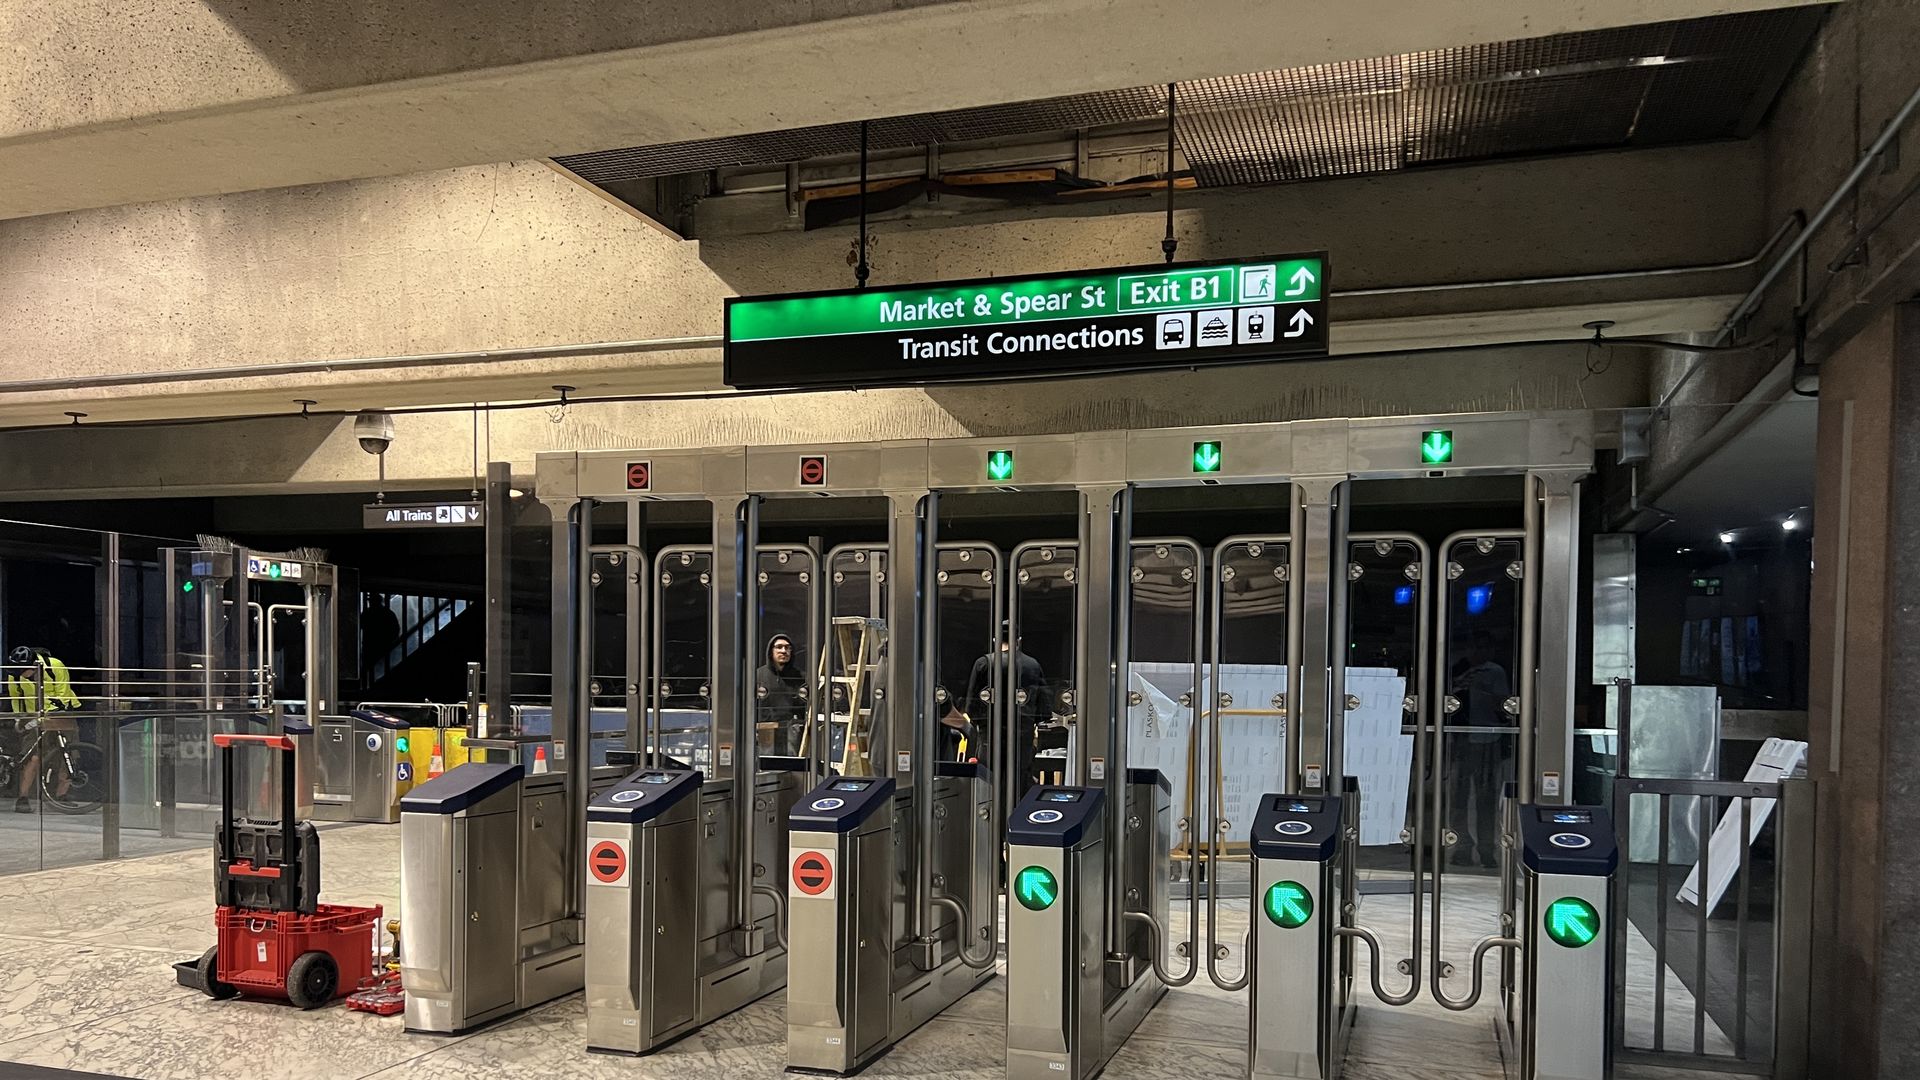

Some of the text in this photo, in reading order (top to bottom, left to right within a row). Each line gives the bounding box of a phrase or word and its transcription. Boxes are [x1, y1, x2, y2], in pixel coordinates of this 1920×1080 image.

[879, 286, 1106, 324] Market & Spear St
[1130, 276, 1222, 305] Exit B1
[898, 327, 1144, 360] Transit Connections
[386, 509, 433, 521] All Trains
[1145, 702, 1154, 738] PLASKO
